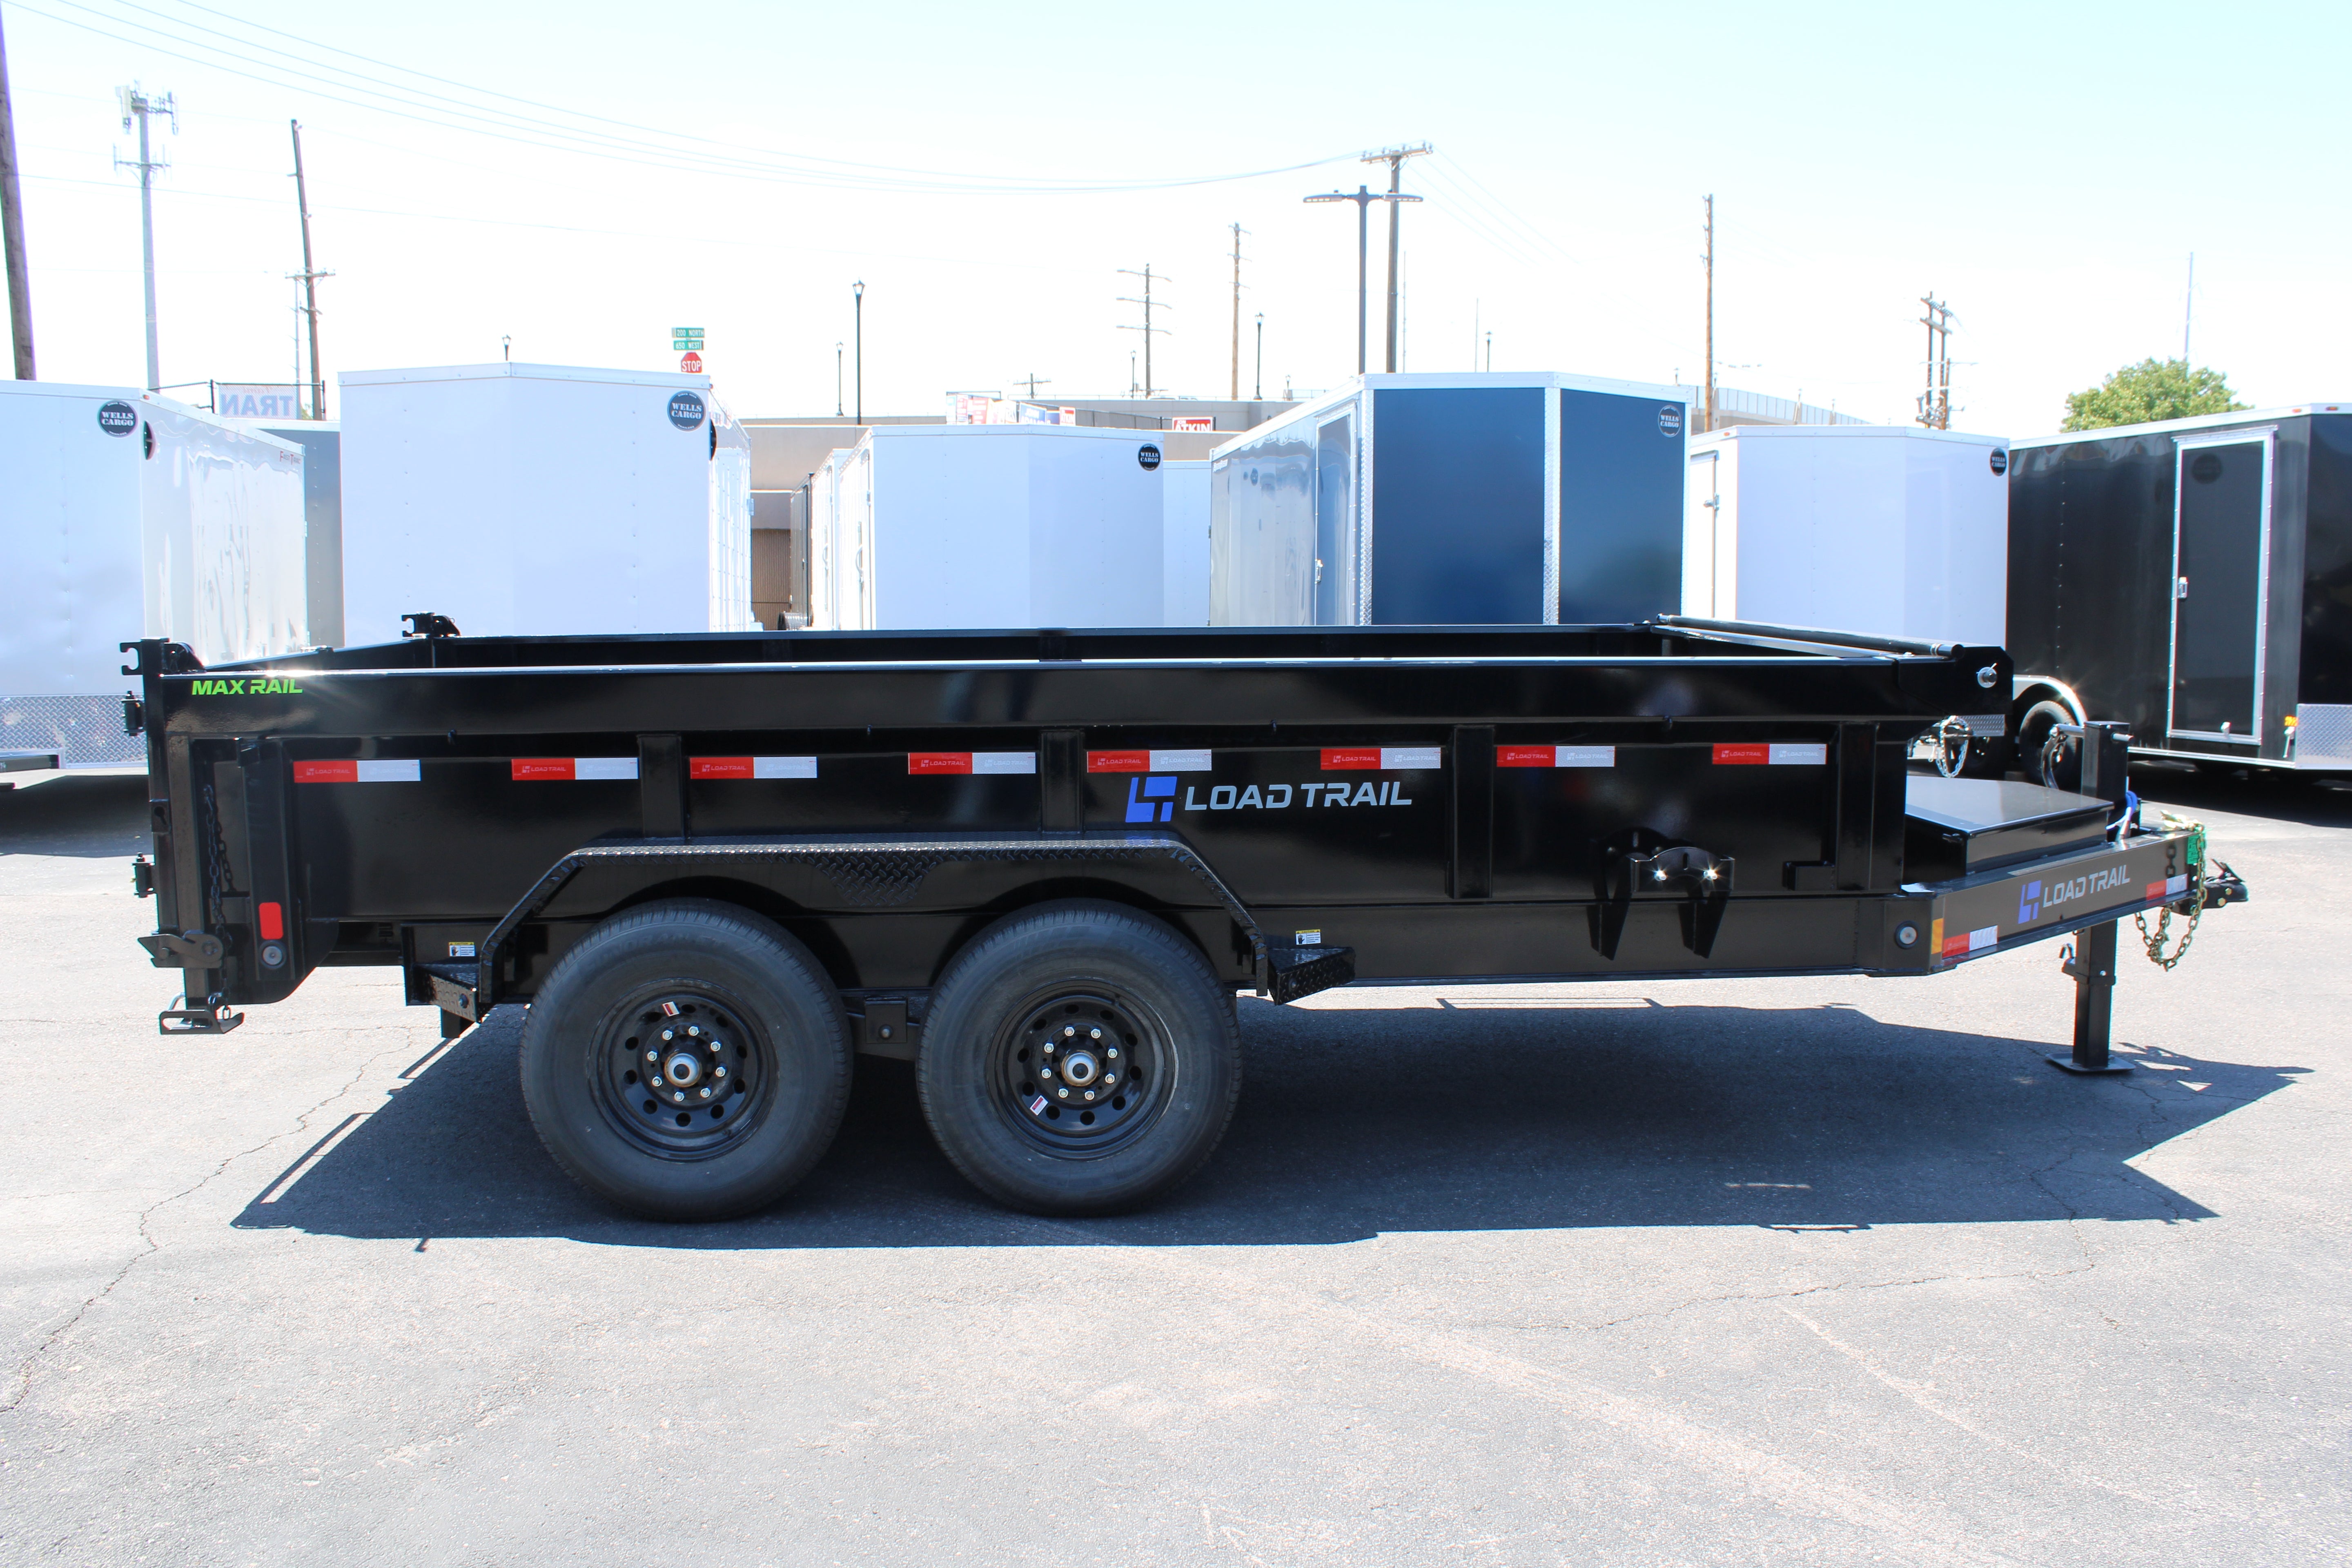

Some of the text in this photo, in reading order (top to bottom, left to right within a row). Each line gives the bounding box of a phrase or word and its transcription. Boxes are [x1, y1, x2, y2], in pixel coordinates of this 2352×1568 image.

[682, 361, 701, 372] STOP
[671, 403, 702, 412] WELLS
[101, 411, 134, 419] WELLS
[671, 410, 702, 419] CARGO
[1176, 423, 1210, 432] ATKIN
[192, 679, 303, 695] MAX RAIL
[1185, 784, 1292, 810] LOAD
[1301, 782, 1412, 808] TRAIL
[2043, 876, 2086, 908] LOAD
[2089, 865, 2130, 894] TRAIL
